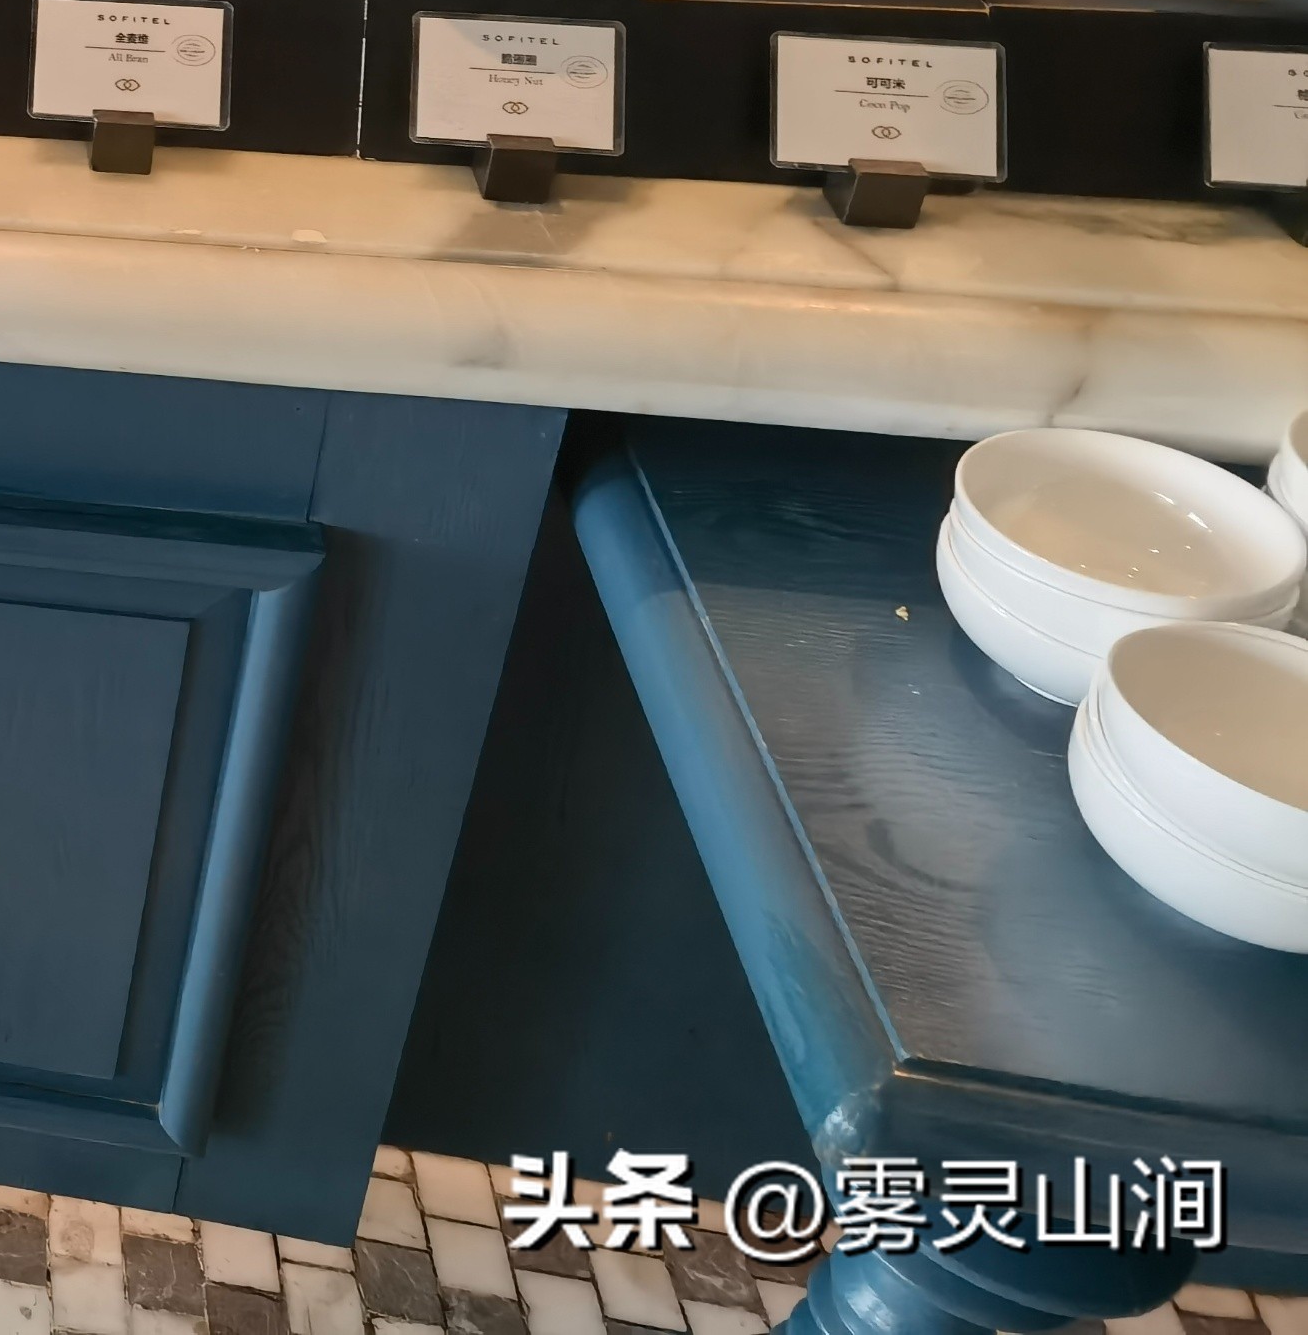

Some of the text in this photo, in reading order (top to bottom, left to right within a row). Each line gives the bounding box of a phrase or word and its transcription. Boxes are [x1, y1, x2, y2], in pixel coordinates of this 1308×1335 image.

[97, 14, 171, 25] SOFITEL
[481, 34, 561, 46] SOFITEL
[108, 53, 124, 62] All
[848, 55, 933, 68] SOFITEL
[866, 76, 906, 90] 可可米
[889, 100, 910, 113] Pop
